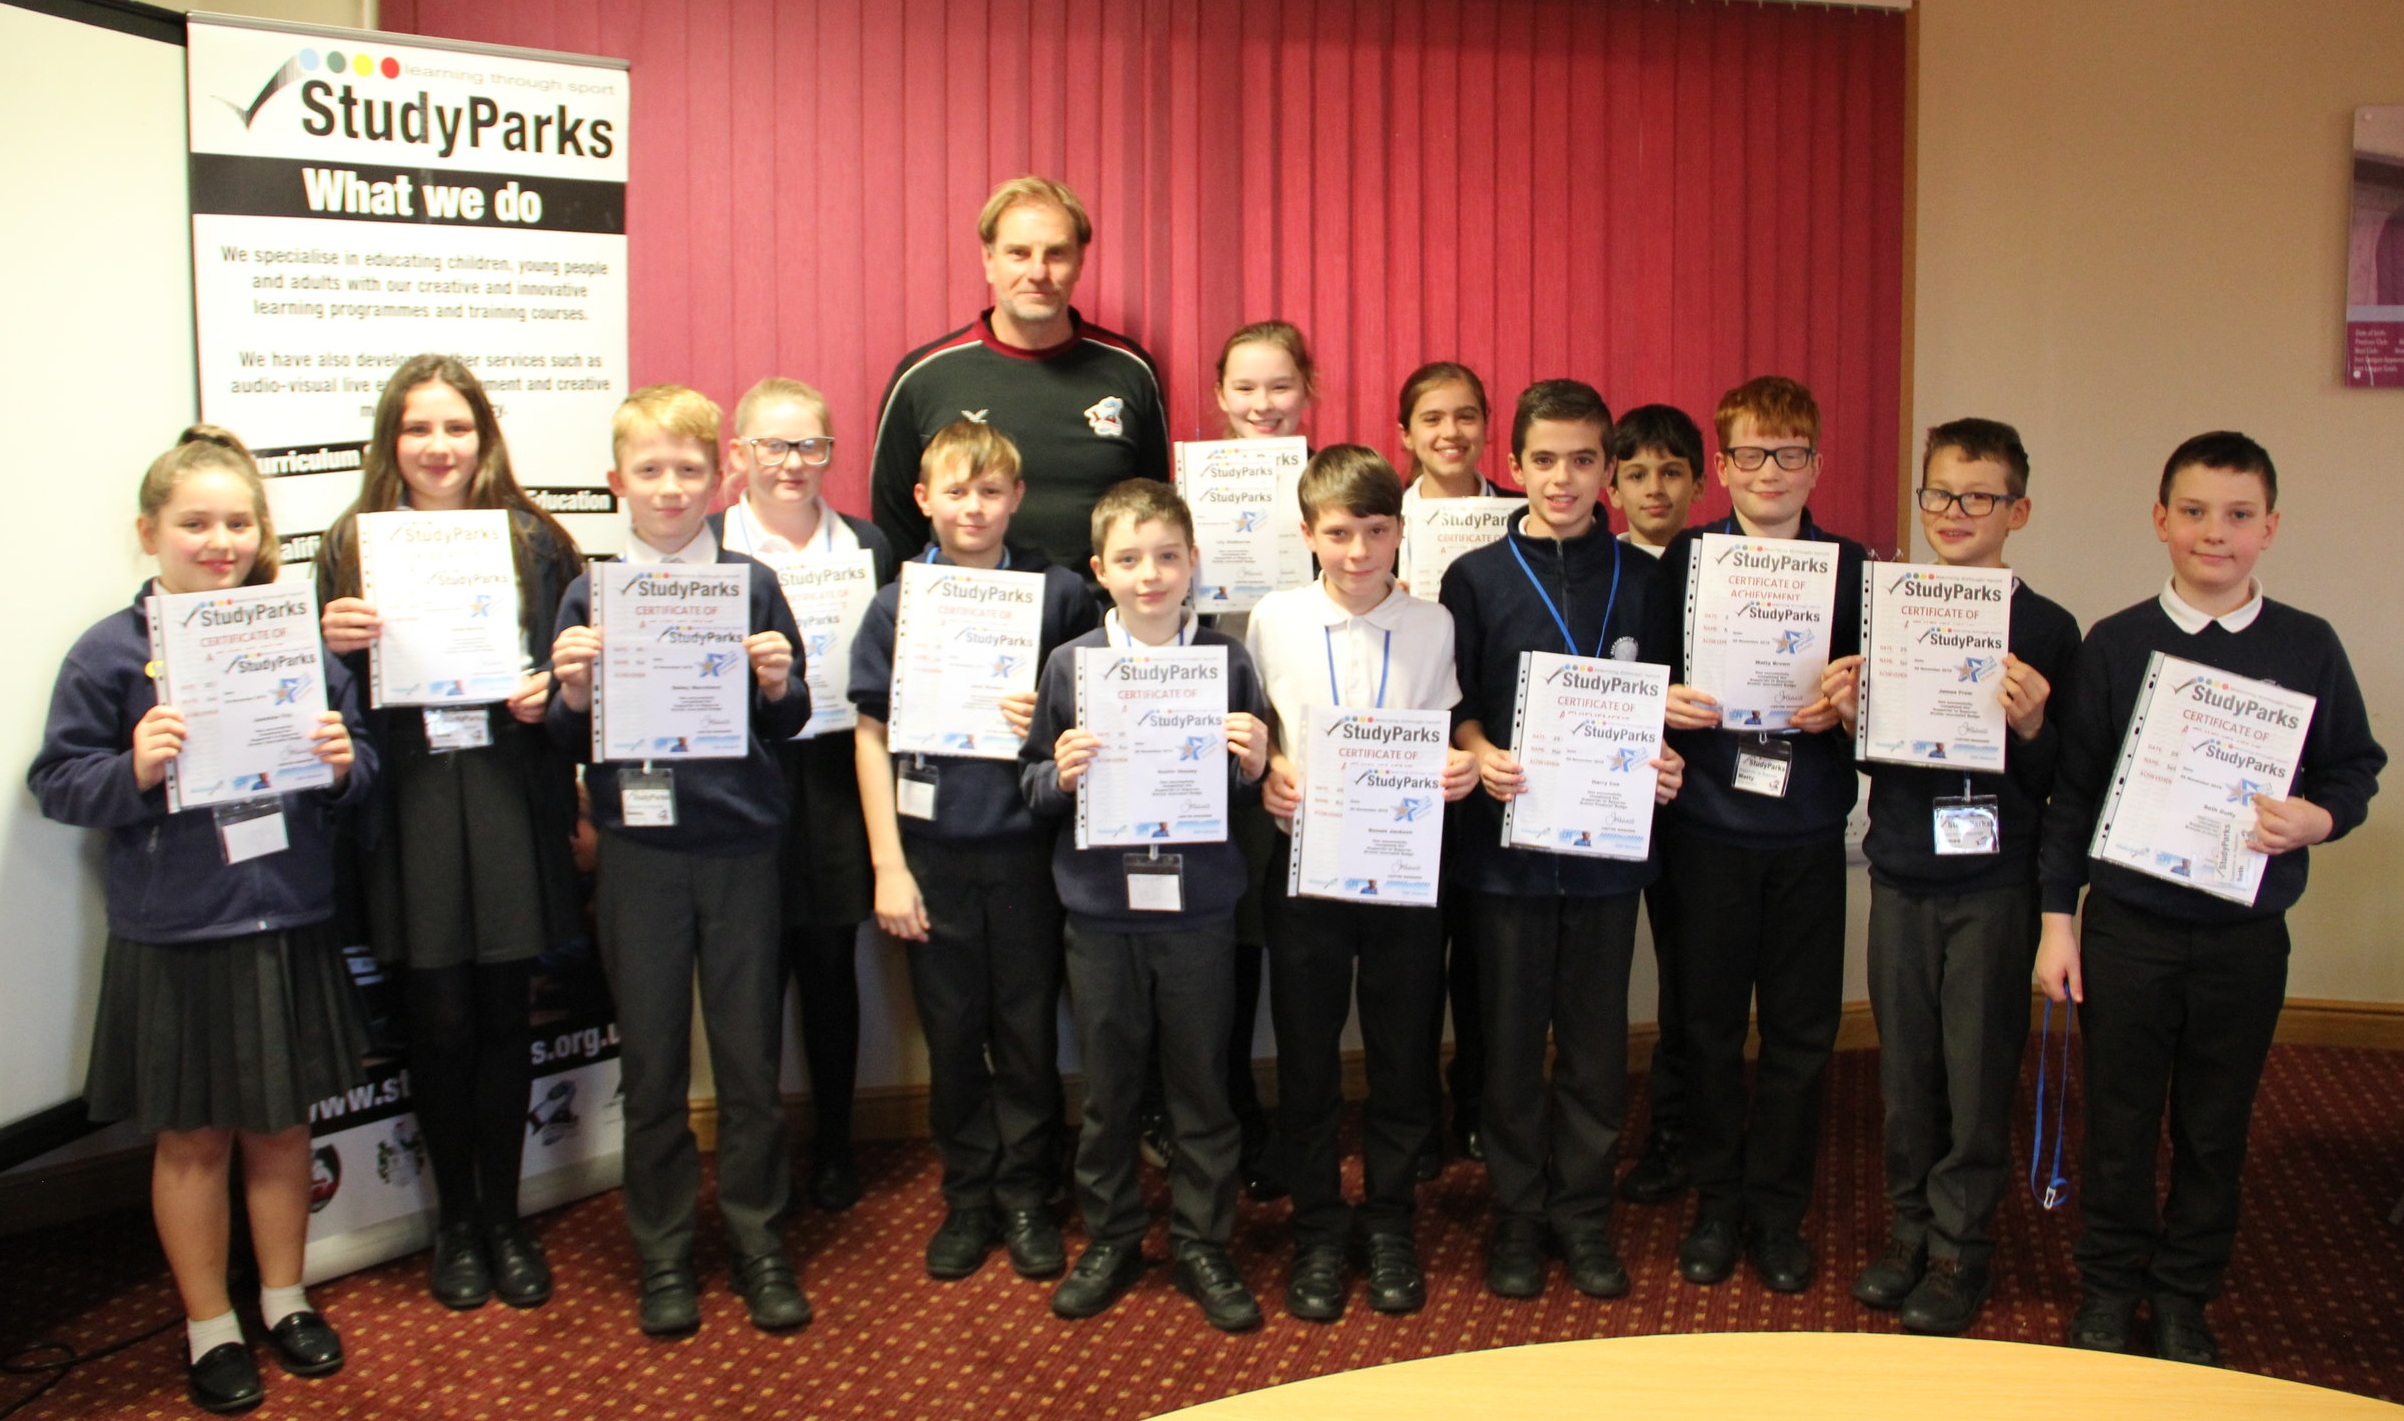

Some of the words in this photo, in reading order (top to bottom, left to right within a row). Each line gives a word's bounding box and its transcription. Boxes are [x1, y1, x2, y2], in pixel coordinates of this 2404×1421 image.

[568, 82, 615, 96] sport
[300, 79, 614, 159] StudyParks
[302, 167, 413, 216] What
[422, 183, 485, 220] we
[494, 181, 543, 223] do
[221, 246, 248, 263] We
[254, 248, 340, 266] specialise
[345, 250, 359, 266] in
[364, 253, 442, 272] educating
[518, 260, 560, 276] young
[563, 261, 609, 277] people
[252, 275, 284, 289] and
[290, 275, 341, 291] adults
[347, 276, 381, 292] with
[386, 280, 412, 293] our
[417, 281, 480, 295] creative
[485, 282, 512, 296] and
[517, 283, 588, 298] innovative
[254, 300, 324, 319] learning
[330, 303, 430, 320] programmes
[435, 305, 463, 319] and
[468, 306, 526, 322] training
[531, 308, 590, 321] courses.
[240, 351, 266, 367] We
[272, 352, 312, 367] have
[318, 353, 350, 368] also
[486, 354, 546, 368] services
[551, 354, 583, 368] such
[587, 356, 602, 368] as
[231, 377, 337, 394] audio-visual
[343, 378, 371, 392] live
[527, 379, 551, 392] and
[557, 379, 610, 392] creative
[1210, 466, 1273, 478] StudyParks
[1209, 491, 1273, 504] StudyParks
[405, 526, 499, 544] StudyParks
[1732, 551, 1828, 574] StudyParks
[780, 566, 866, 587] StudyParks
[1728, 575, 1789, 588] CERTIFICATE
[1792, 580, 1806, 590] OF
[638, 579, 739, 601] StudyParks
[942, 581, 1033, 604] StudyParks
[1904, 580, 2002, 602] StudyParks
[200, 600, 308, 628] StudyParks
[635, 605, 700, 616] CERTIFICATE
[703, 605, 718, 616] OF
[938, 605, 997, 619] CERTIFICATE
[998, 610, 1013, 620] OF
[1750, 606, 1820, 622] StudyParks
[1901, 605, 1963, 619] CERTIFICATE
[1965, 609, 1980, 620] OF
[200, 630, 268, 648] CERTIFICATE
[271, 627, 288, 639] OF
[669, 631, 743, 646] StudyParks
[965, 631, 1033, 648] StudyParks
[1930, 633, 2002, 649] StudyParks
[237, 652, 316, 674] StudyParks
[1120, 664, 1218, 683] StudyParks
[1562, 672, 1659, 697] StudyParks
[1117, 689, 1179, 700] CERTIFICATE
[1183, 689, 1197, 699] OF
[1557, 696, 1619, 712] CERTIFICATE
[1621, 702, 1635, 713] OF
[2191, 684, 2299, 729] StudyParks
[1150, 713, 1223, 729] StudyParks
[2183, 709, 2251, 737] CERTIFICATE
[2253, 729, 2270, 742] OF
[1342, 723, 1441, 744] StudyParks
[1583, 725, 1656, 743] StudyParks
[1338, 747, 1402, 760] CERTIFICATE
[1404, 751, 1418, 761] OF
[2205, 744, 2286, 778] StudyParks
[1367, 774, 1439, 790] StudyParks
[2218, 824, 2231, 870] StudyParks
